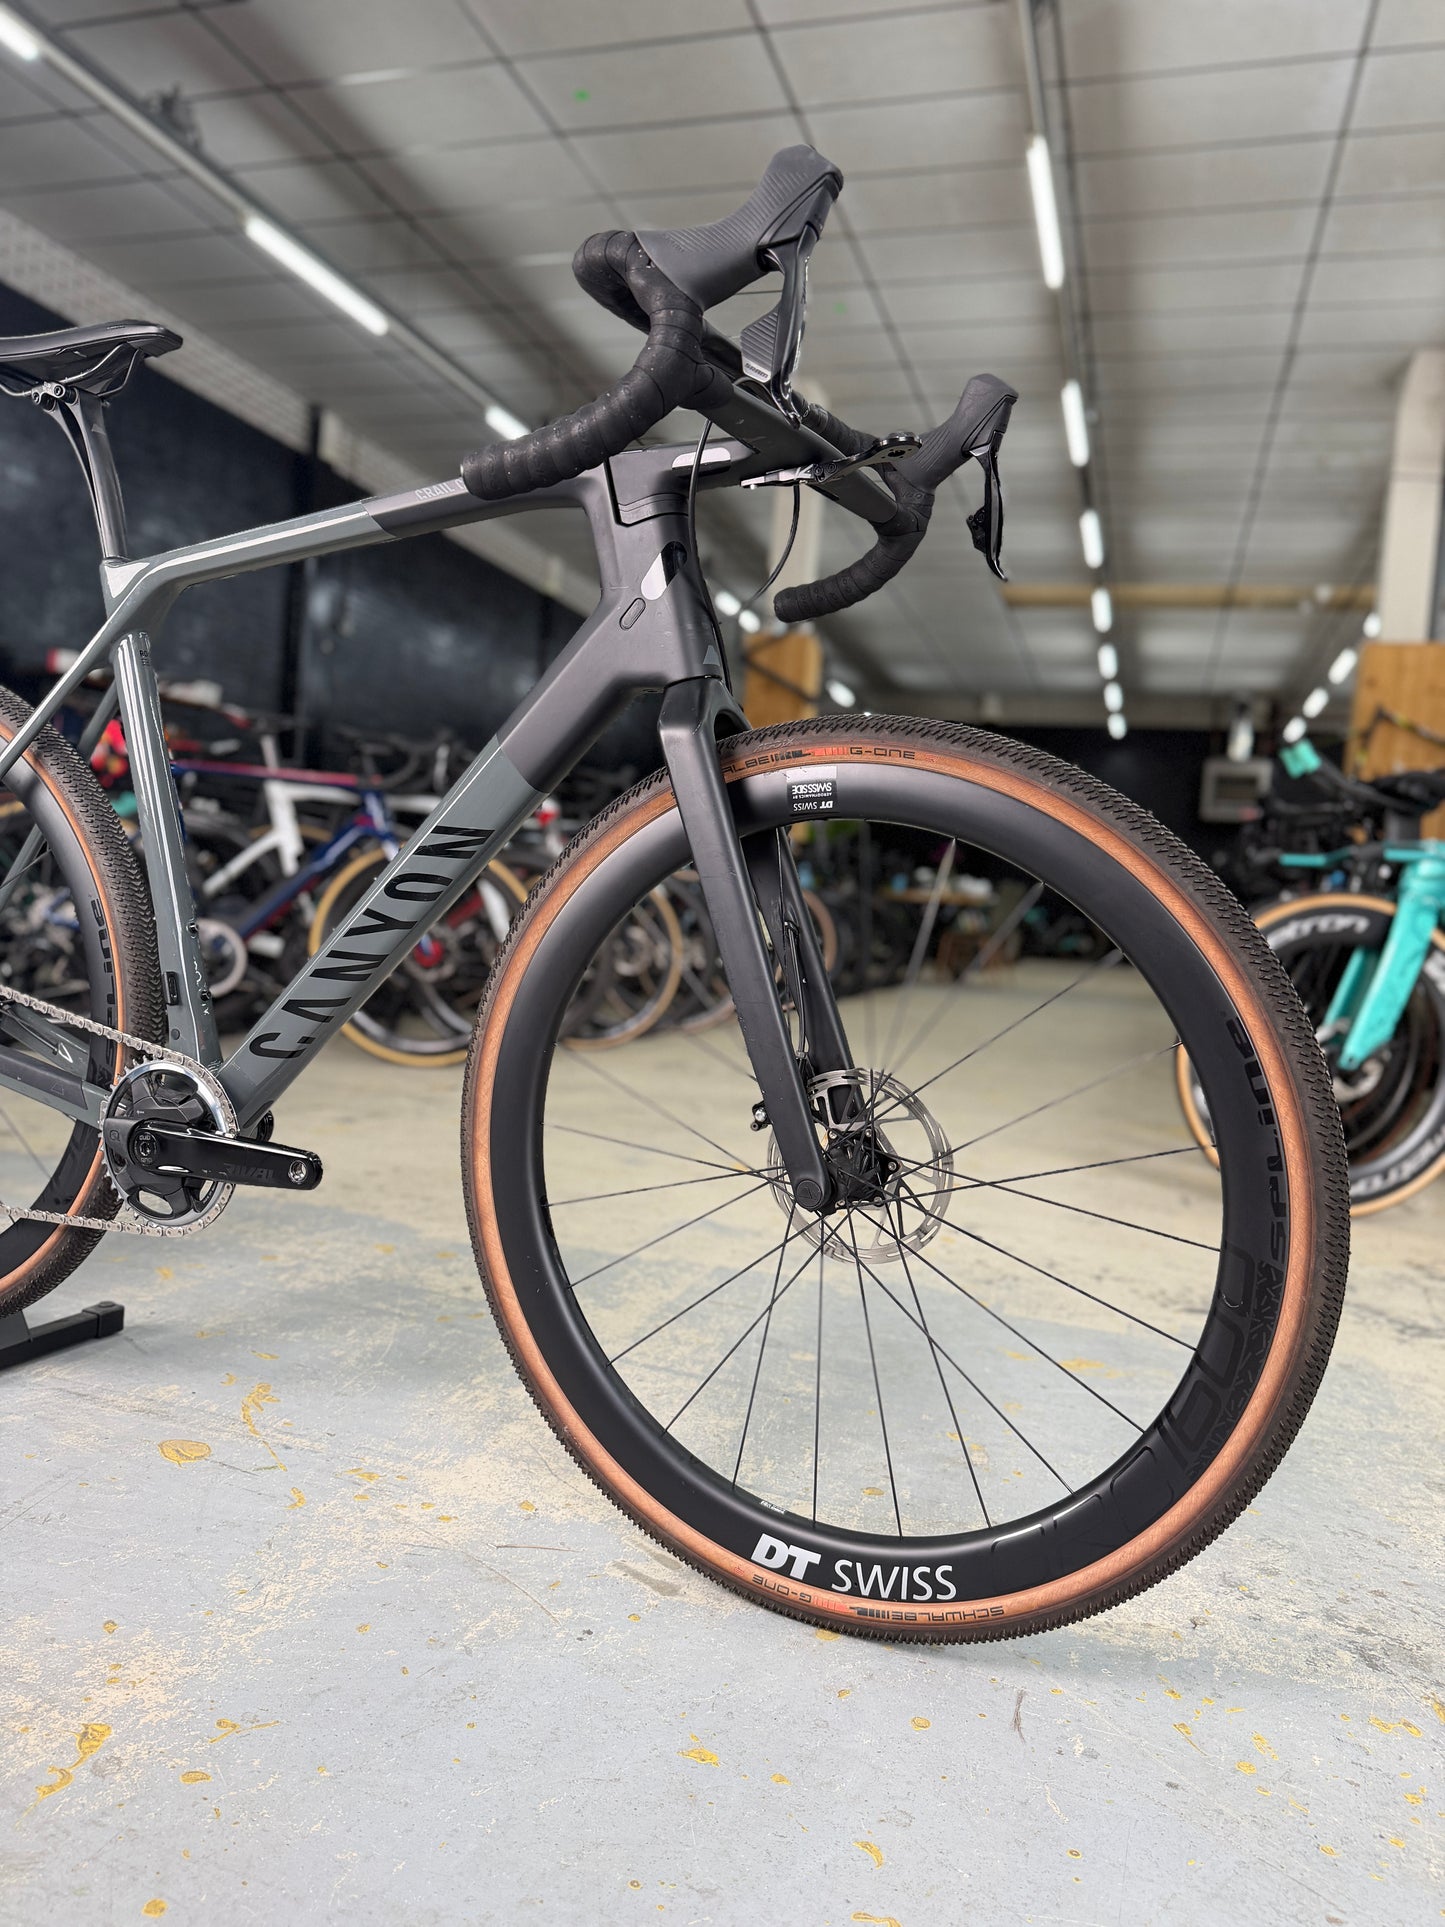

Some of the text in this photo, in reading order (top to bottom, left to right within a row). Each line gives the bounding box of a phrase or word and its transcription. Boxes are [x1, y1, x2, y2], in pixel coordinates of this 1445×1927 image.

[721, 755, 770, 774] ALBE
[849, 746, 917, 761] G-ONE
[793, 800, 834, 811] DT SWISS
[249, 825, 496, 1060] CANYON
[749, 1532, 958, 1601] DT SWISS
[751, 1573, 812, 1604] G-ONE
[890, 1605, 1005, 1623] SCHWALBE
